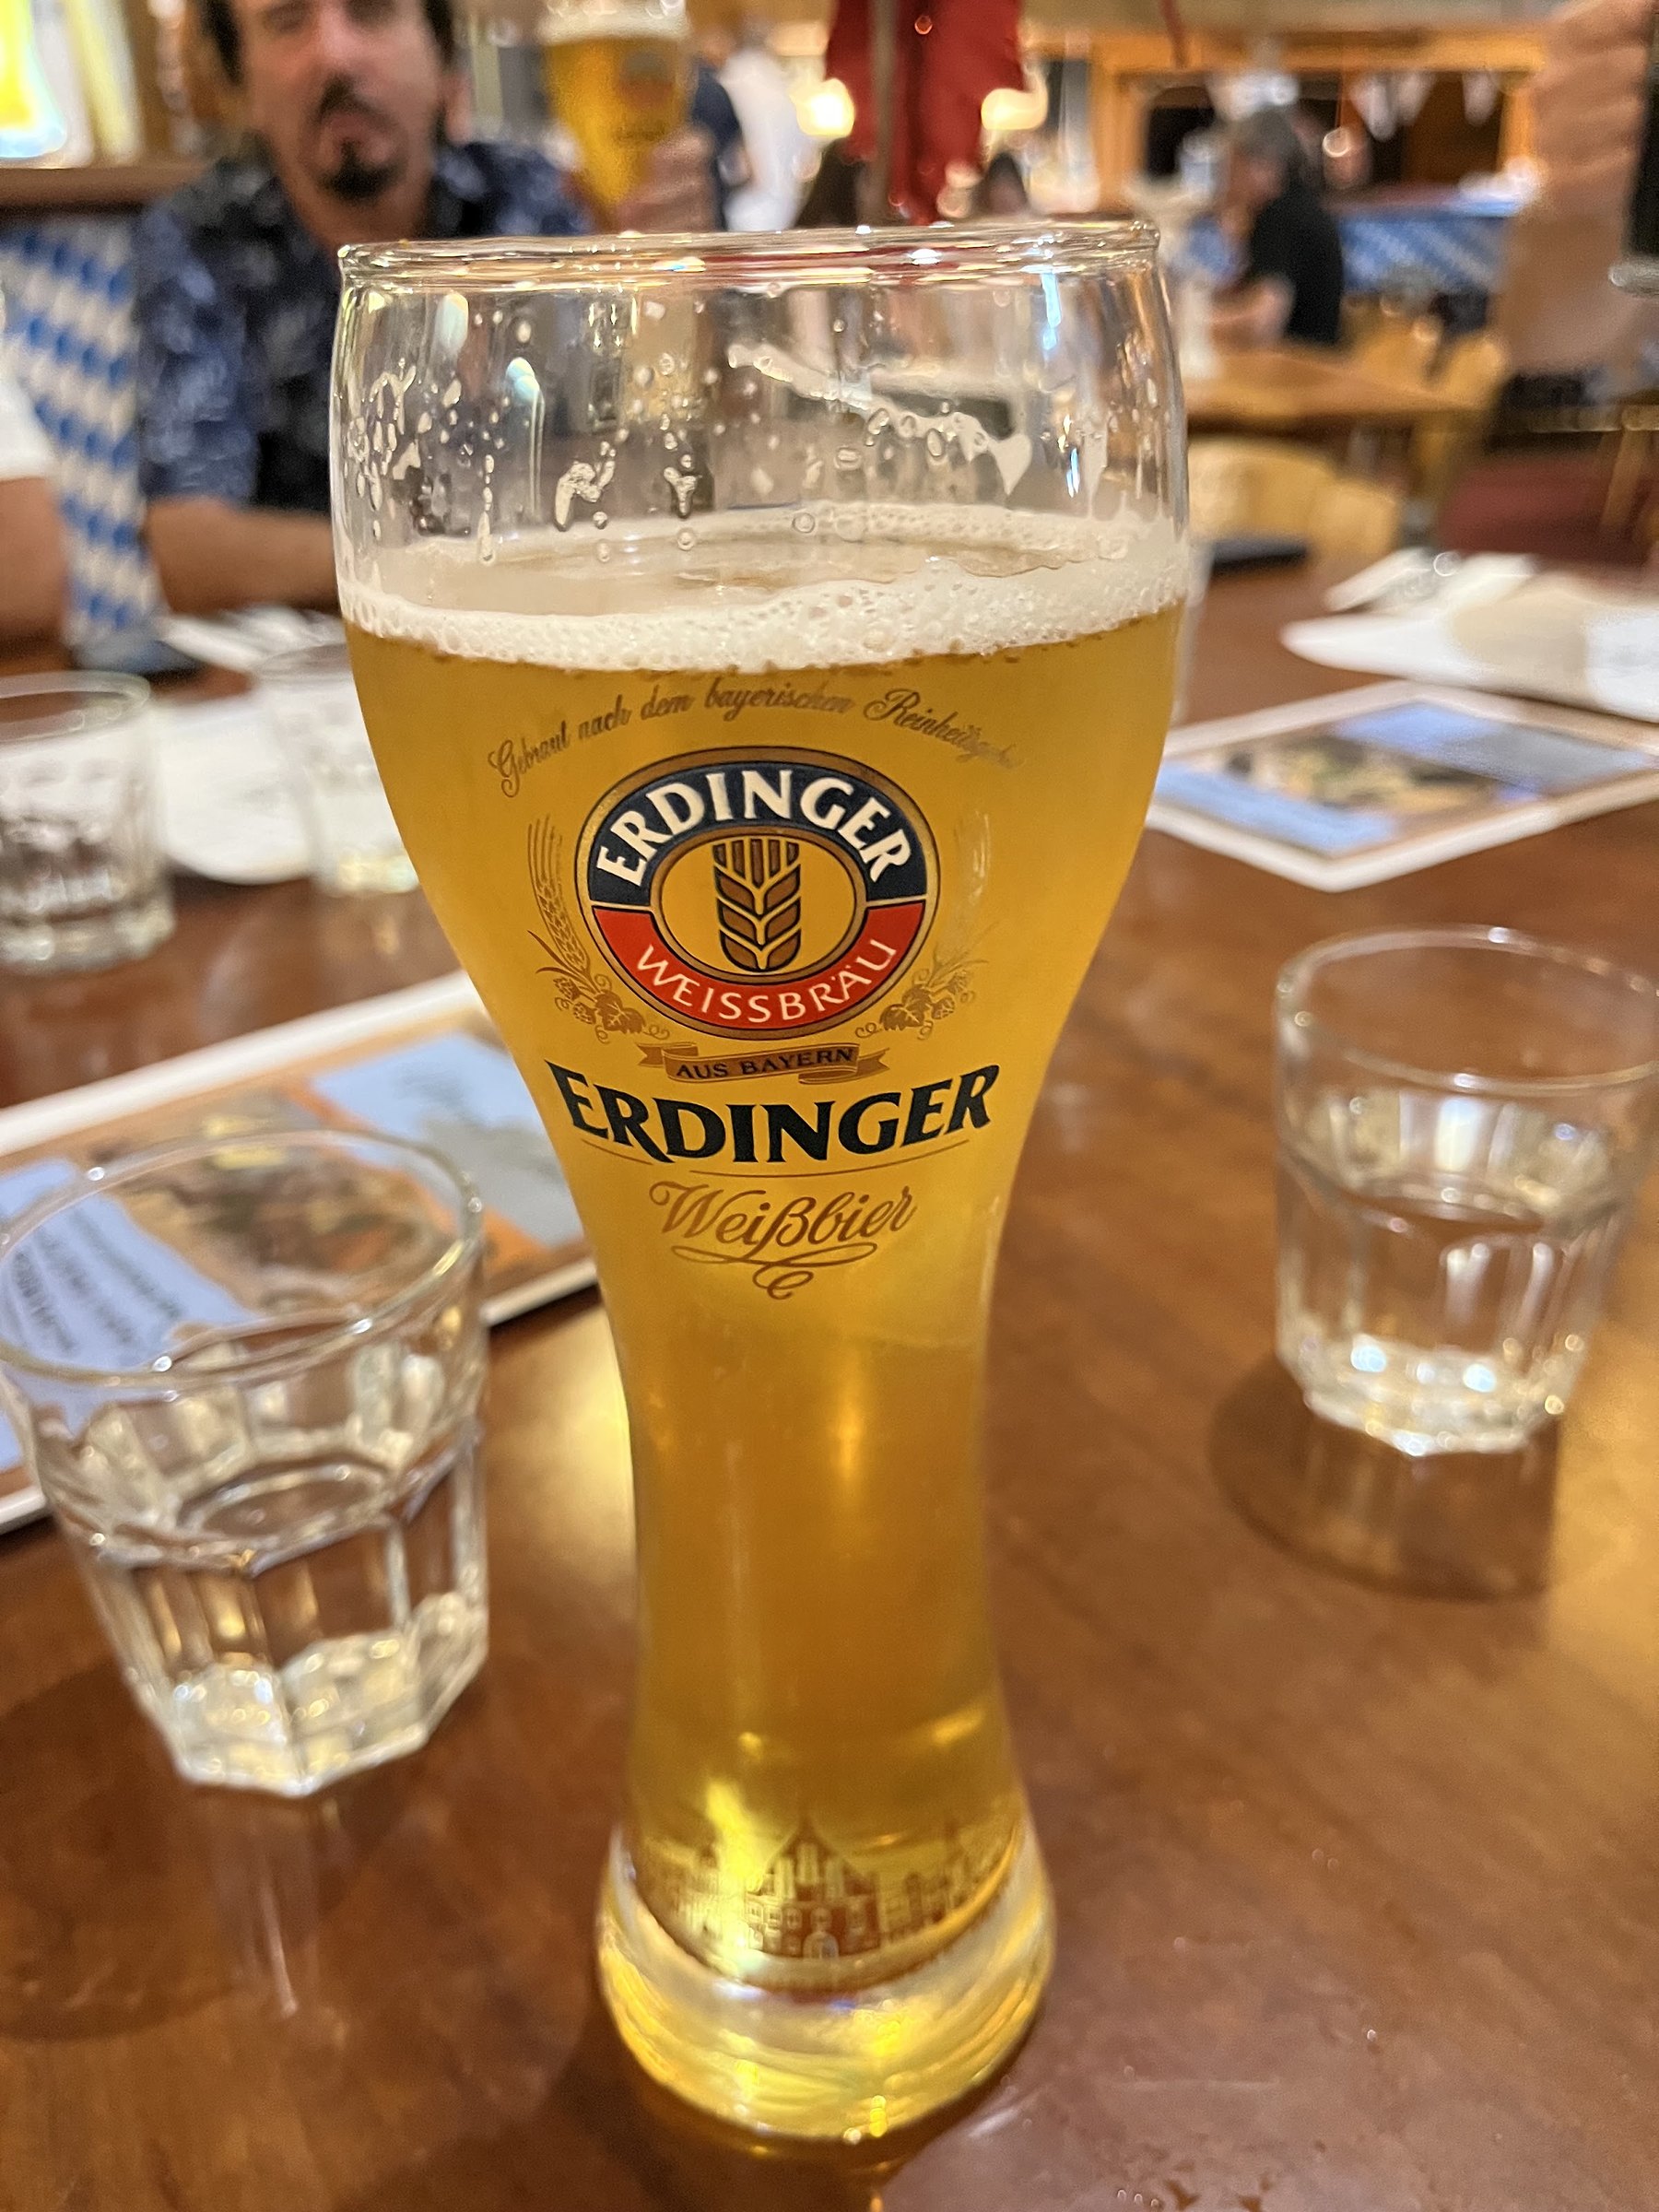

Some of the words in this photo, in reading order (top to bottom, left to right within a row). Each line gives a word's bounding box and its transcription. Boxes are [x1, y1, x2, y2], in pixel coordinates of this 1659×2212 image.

[578, 696, 631, 740] nach
[641, 685, 694, 720] dem
[704, 677, 855, 722] bayerischen
[596, 769, 912, 887] ERDINGER
[637, 938, 898, 1024] WEISSBRÄU
[677, 1063, 729, 1080] AUS
[740, 1048, 854, 1075] BAYERN
[543, 1059, 1001, 1164] ERDINGER
[649, 1181, 918, 1268] Weißbier
